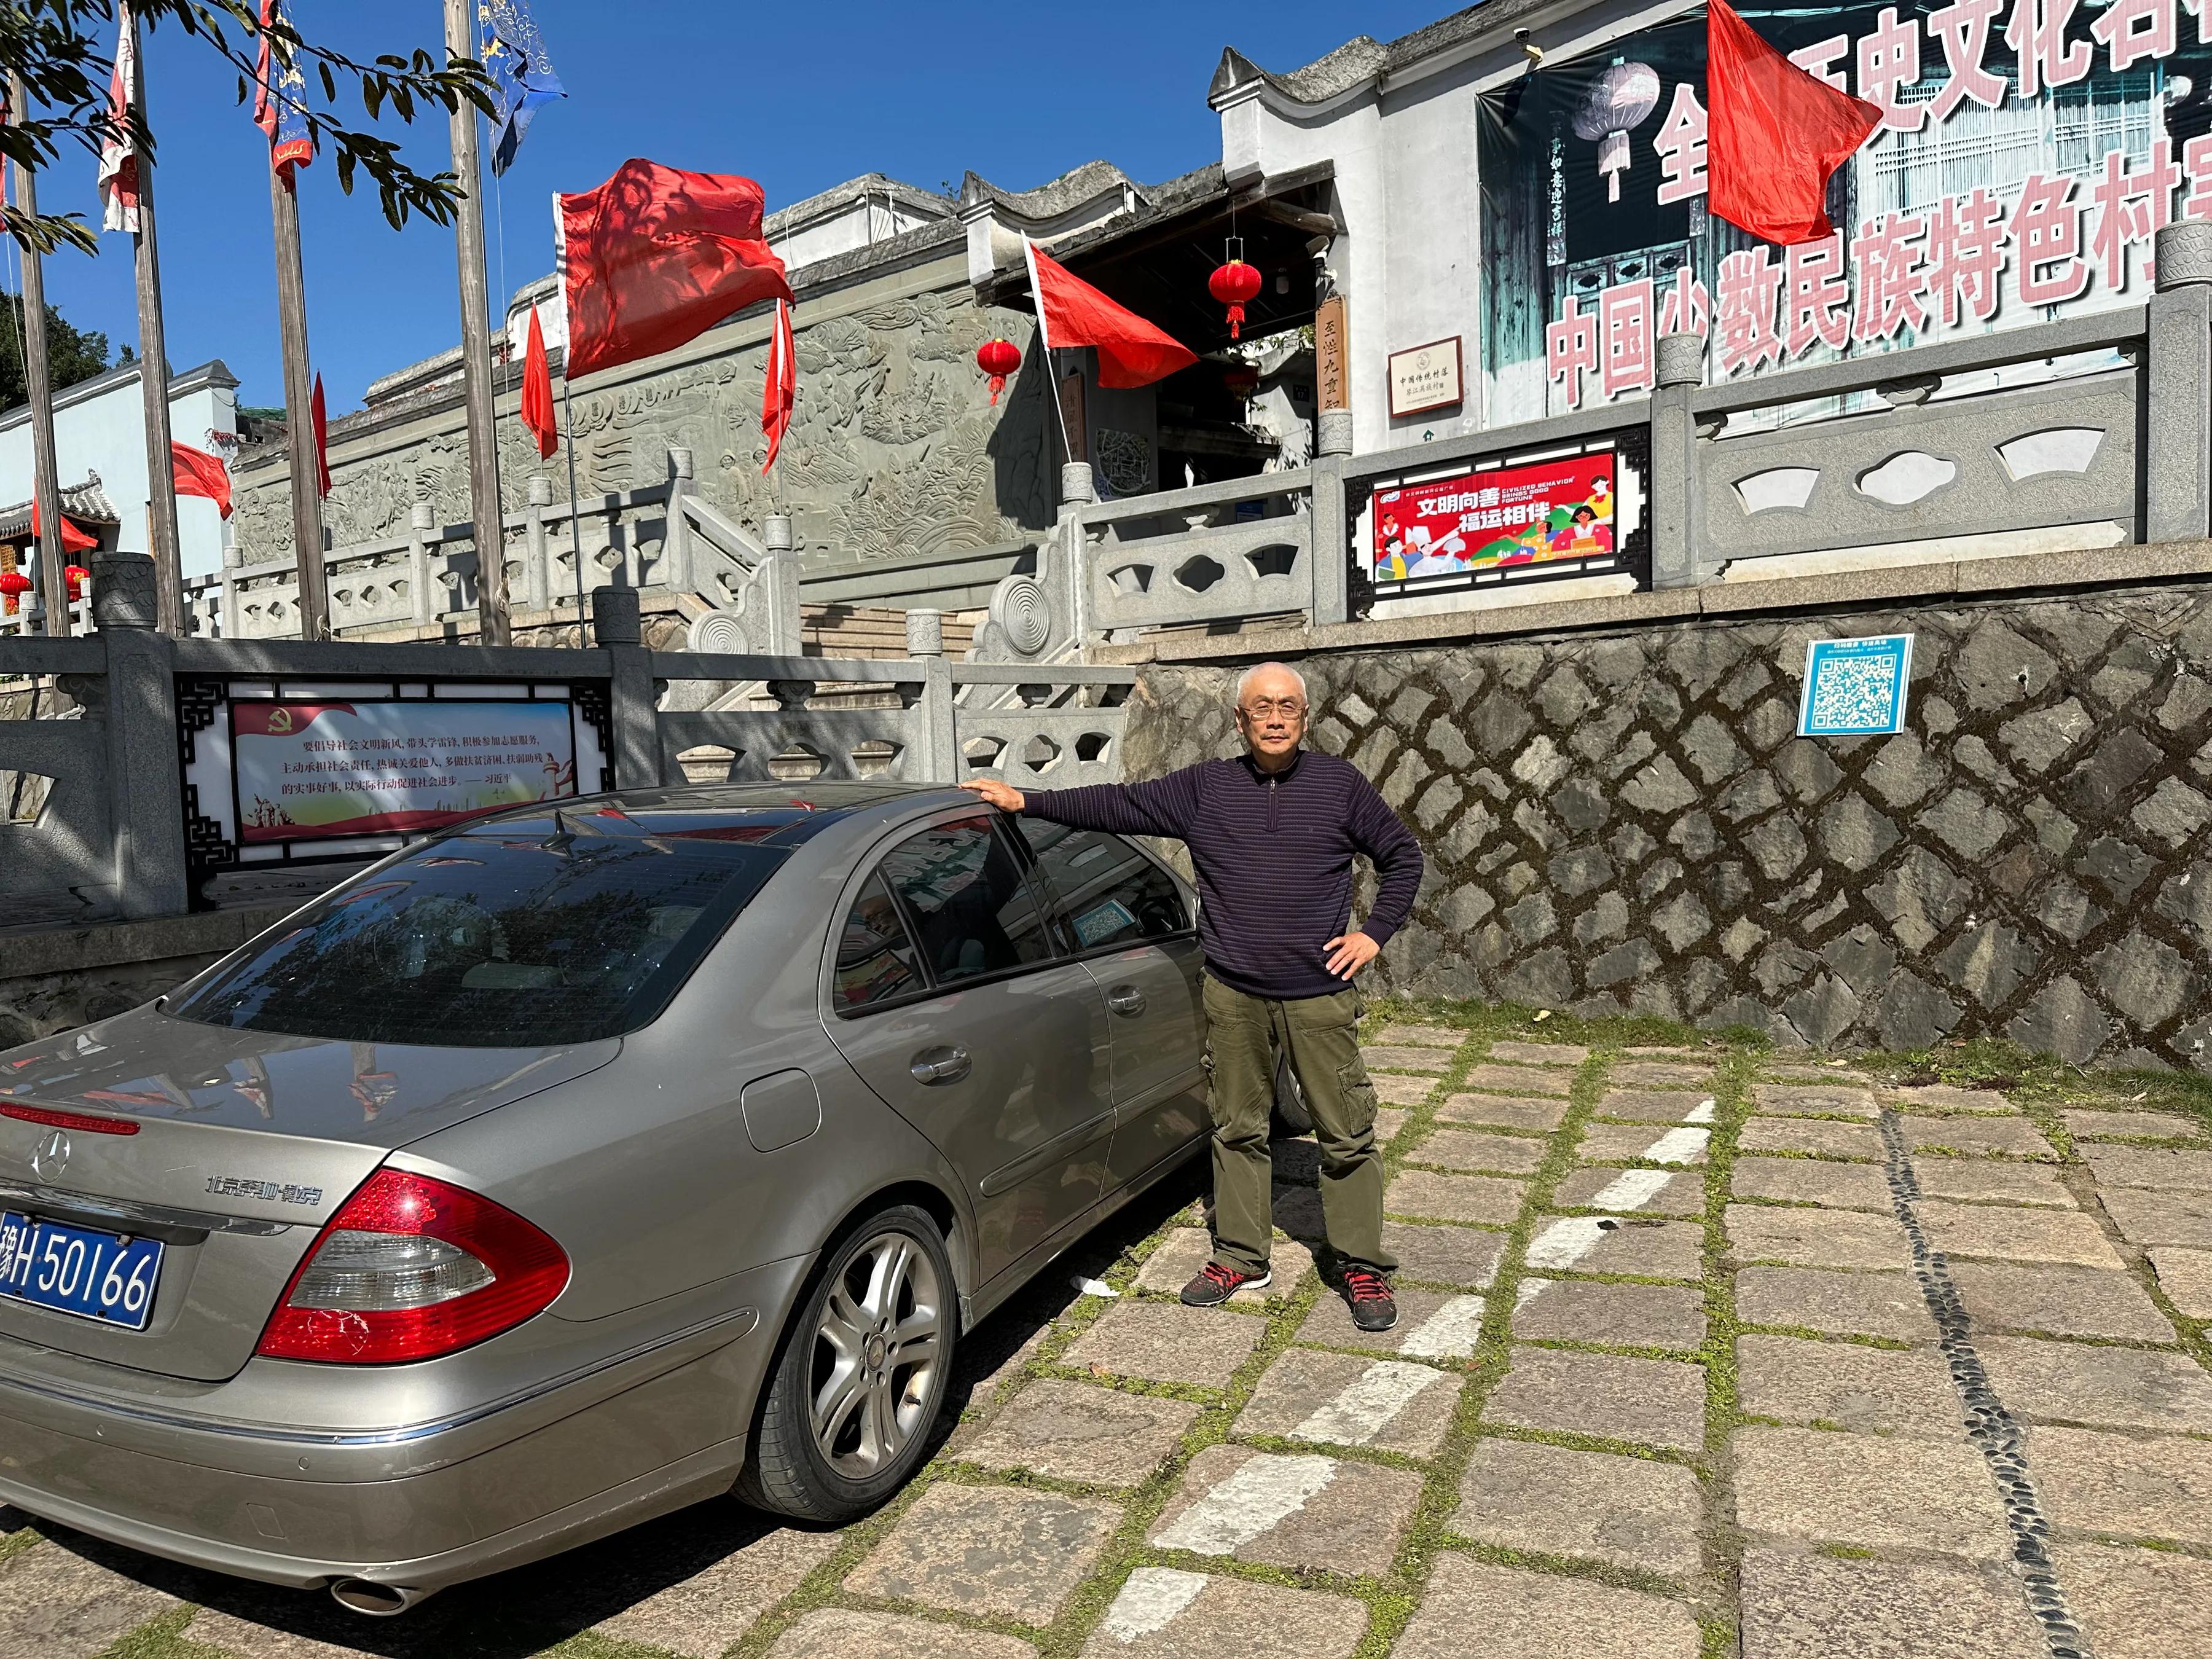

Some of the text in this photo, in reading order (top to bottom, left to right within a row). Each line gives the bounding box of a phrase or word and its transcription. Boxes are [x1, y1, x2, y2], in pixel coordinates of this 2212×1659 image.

[1502, 484, 1535, 494] CIVILIZED
[1502, 490, 1528, 500] BRINGS
[1502, 495, 1533, 504] FORTUNE
[1416, 487, 1500, 519] 文明向善
[1459, 501, 1550, 533] 福运相伴
